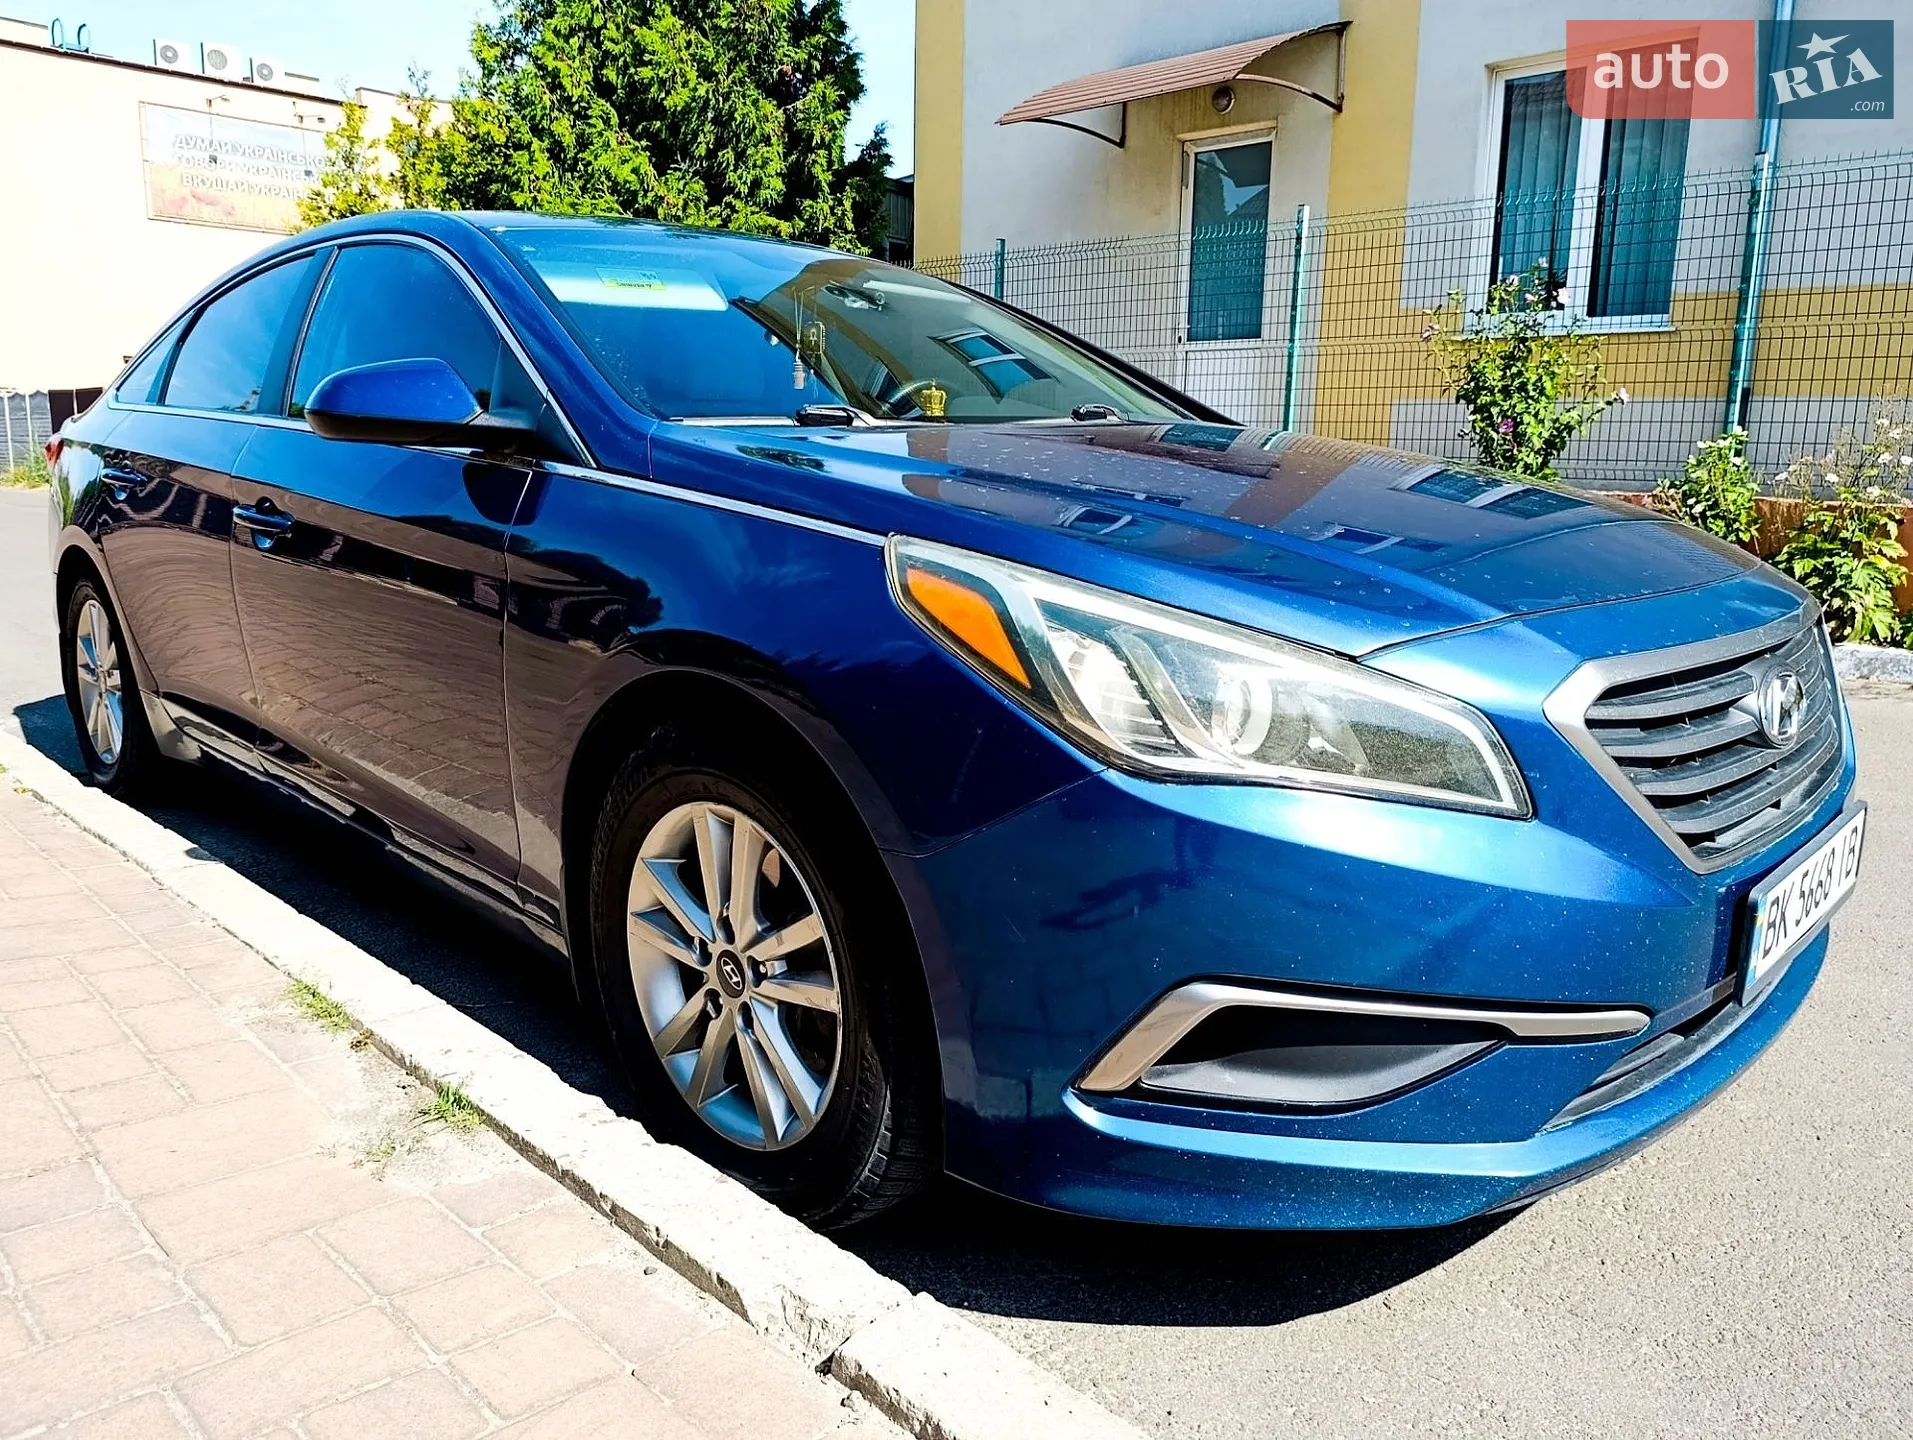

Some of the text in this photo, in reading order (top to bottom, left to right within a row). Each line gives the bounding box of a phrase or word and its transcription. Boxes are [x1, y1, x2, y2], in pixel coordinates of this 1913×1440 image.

[175, 134, 325, 168] ДУМАЙ УКРАЇНСЬКО
[240, 161, 321, 186] УКРАЇНСЬК
[1762, 825, 1858, 960] BK 5668 IB
